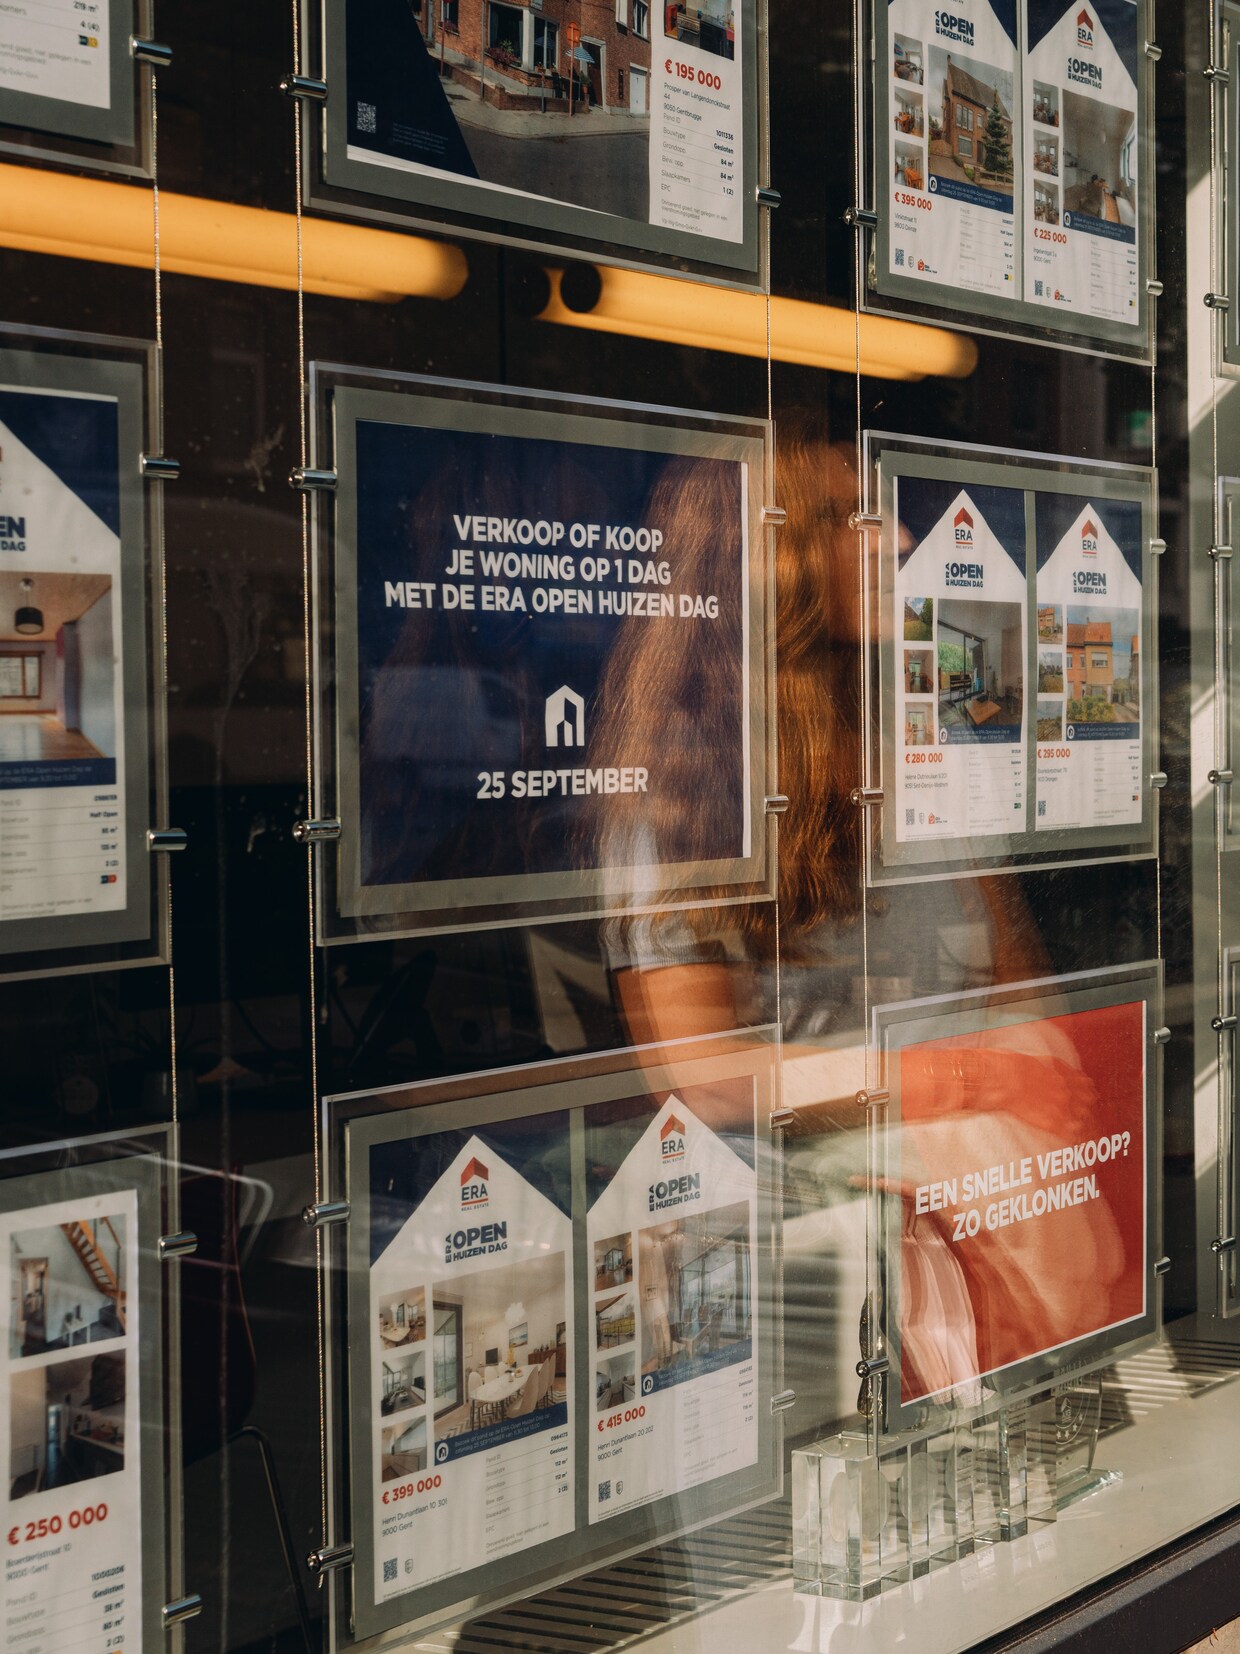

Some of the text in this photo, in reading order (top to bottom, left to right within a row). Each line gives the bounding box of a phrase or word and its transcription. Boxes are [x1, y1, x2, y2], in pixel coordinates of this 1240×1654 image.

[940, 12, 975, 38] OPEN
[940, 28, 975, 46] HUIZEN DAG
[1077, 27, 1093, 42] ERA
[664, 59, 722, 91] € 195 000
[1072, 58, 1102, 81] OPEN
[663, 82, 681, 95] Prosper
[1071, 73, 1102, 90] HUIZEN DAG
[894, 192, 933, 212] € 395 000
[1034, 228, 1067, 244] € 225 000
[453, 514, 664, 553] VERKOOP OF KOOP
[954, 528, 973, 542] ERA
[1, 540, 26, 552] DAG
[1082, 539, 1097, 551] ERA
[445, 549, 672, 586] JE WONING OP 1 DAG
[950, 562, 984, 580] OPEN
[950, 579, 984, 588] HUIZEN DAG
[1077, 571, 1107, 587] OPEN
[384, 581, 719, 619] MET DE ERA OPEN HUIZEN DAG
[1077, 587, 1107, 595] HUIZEN DAG
[905, 752, 943, 764] € 280 000
[1037, 748, 1071, 759] € 295 000
[476, 767, 649, 800] 25 SEPTEMBER
[661, 1138, 685, 1155] ERA
[915, 1131, 1131, 1216] EEN SNELLE VERKOOP?
[461, 1183, 489, 1202] ERA
[655, 1172, 700, 1200] OPEN
[473, 1202, 489, 1210] ESTATE
[655, 1191, 701, 1211] HUIZEN DAG
[952, 1174, 1100, 1242] ZO GEKLONKEN.
[453, 1221, 507, 1250] OPEN
[453, 1241, 508, 1262] HUIZEN DAG
[597, 1405, 646, 1432] € 415 000
[597, 1447, 623, 1461] 9000 Gent
[598, 1441, 611, 1451] Henri
[382, 1474, 442, 1505] € 399 000
[8, 1503, 108, 1546] € 250 000
[398, 1521, 414, 1532] Gent
